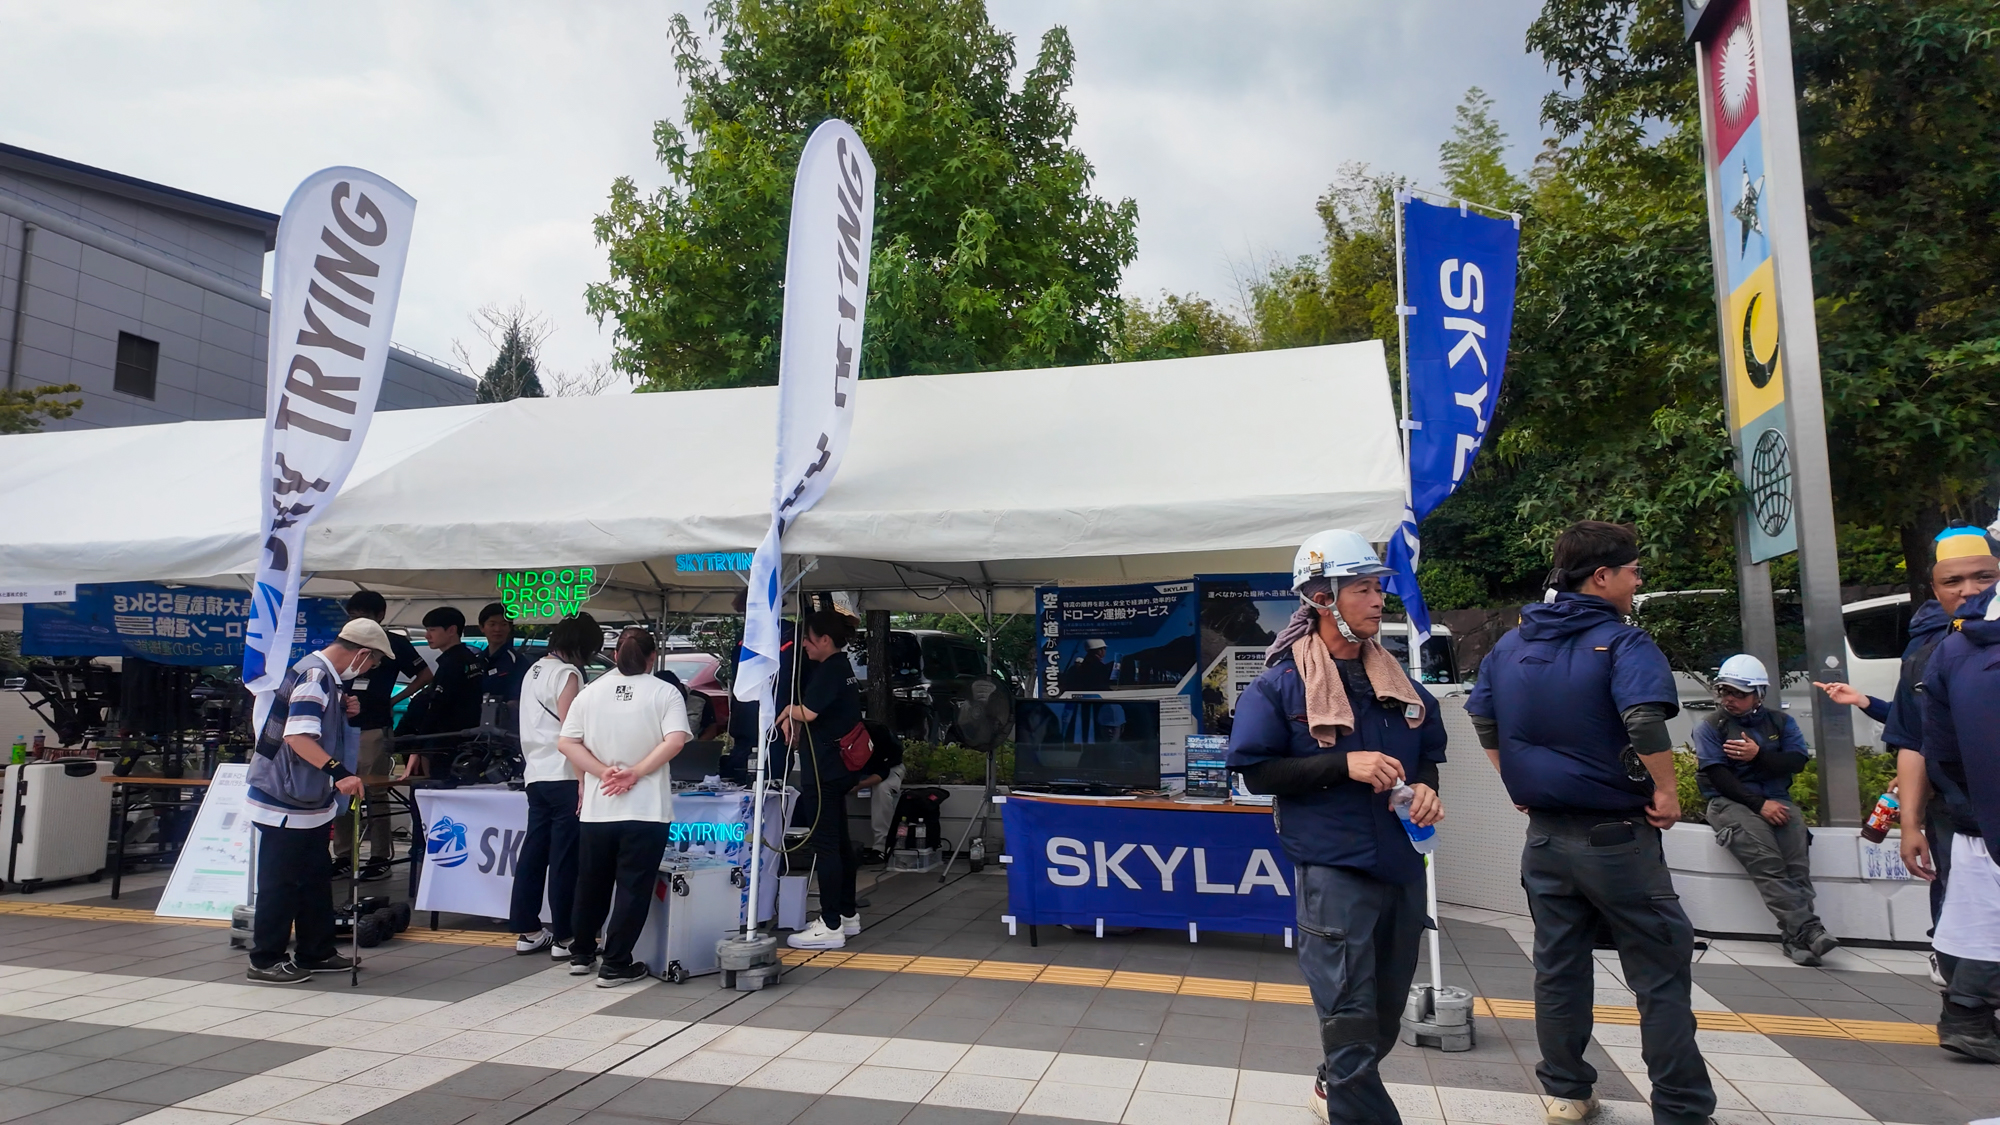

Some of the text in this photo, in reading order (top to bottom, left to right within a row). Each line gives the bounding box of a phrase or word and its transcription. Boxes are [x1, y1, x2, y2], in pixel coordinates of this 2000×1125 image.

[275, 181, 388, 442] TRYING
[1439, 258, 1488, 494] SKYL
[675, 552, 753, 572] SKYTRYIN
[497, 568, 595, 588] INDOOR
[502, 584, 588, 604] DRONE
[1163, 585, 1188, 593] SKYLAB
[505, 600, 581, 620] SHOW
[1063, 605, 1170, 621] ドローン運搬サービス
[1043, 592, 1060, 697] 空に道ができる
[668, 822, 745, 842] SKYTRYING
[477, 826, 526, 877] SK
[1046, 836, 1291, 896] SKYLA
